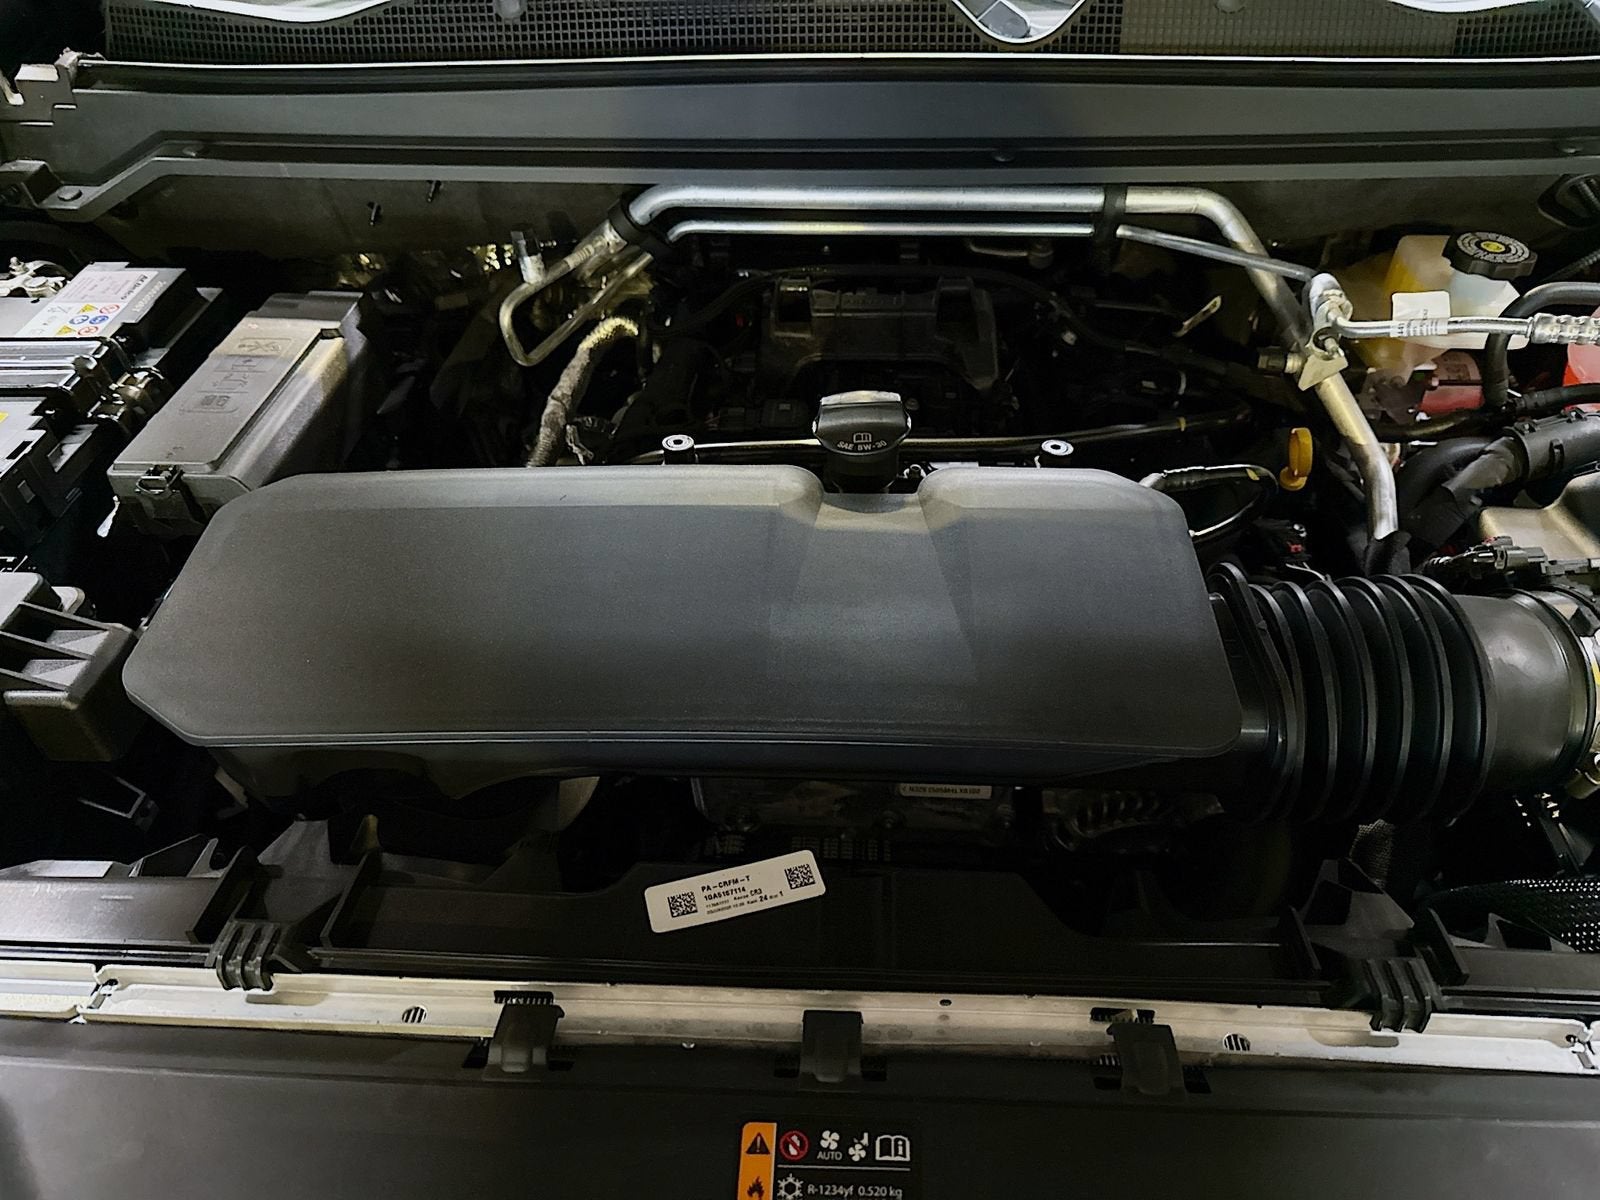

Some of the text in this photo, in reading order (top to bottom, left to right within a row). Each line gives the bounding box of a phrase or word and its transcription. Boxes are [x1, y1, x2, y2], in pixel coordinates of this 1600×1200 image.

[837, 440, 854, 450] SAE
[759, 894, 768, 902] 24
[817, 1151, 842, 1160] AUTO
[807, 1183, 903, 1200] R-1234yf 0.520 kg
